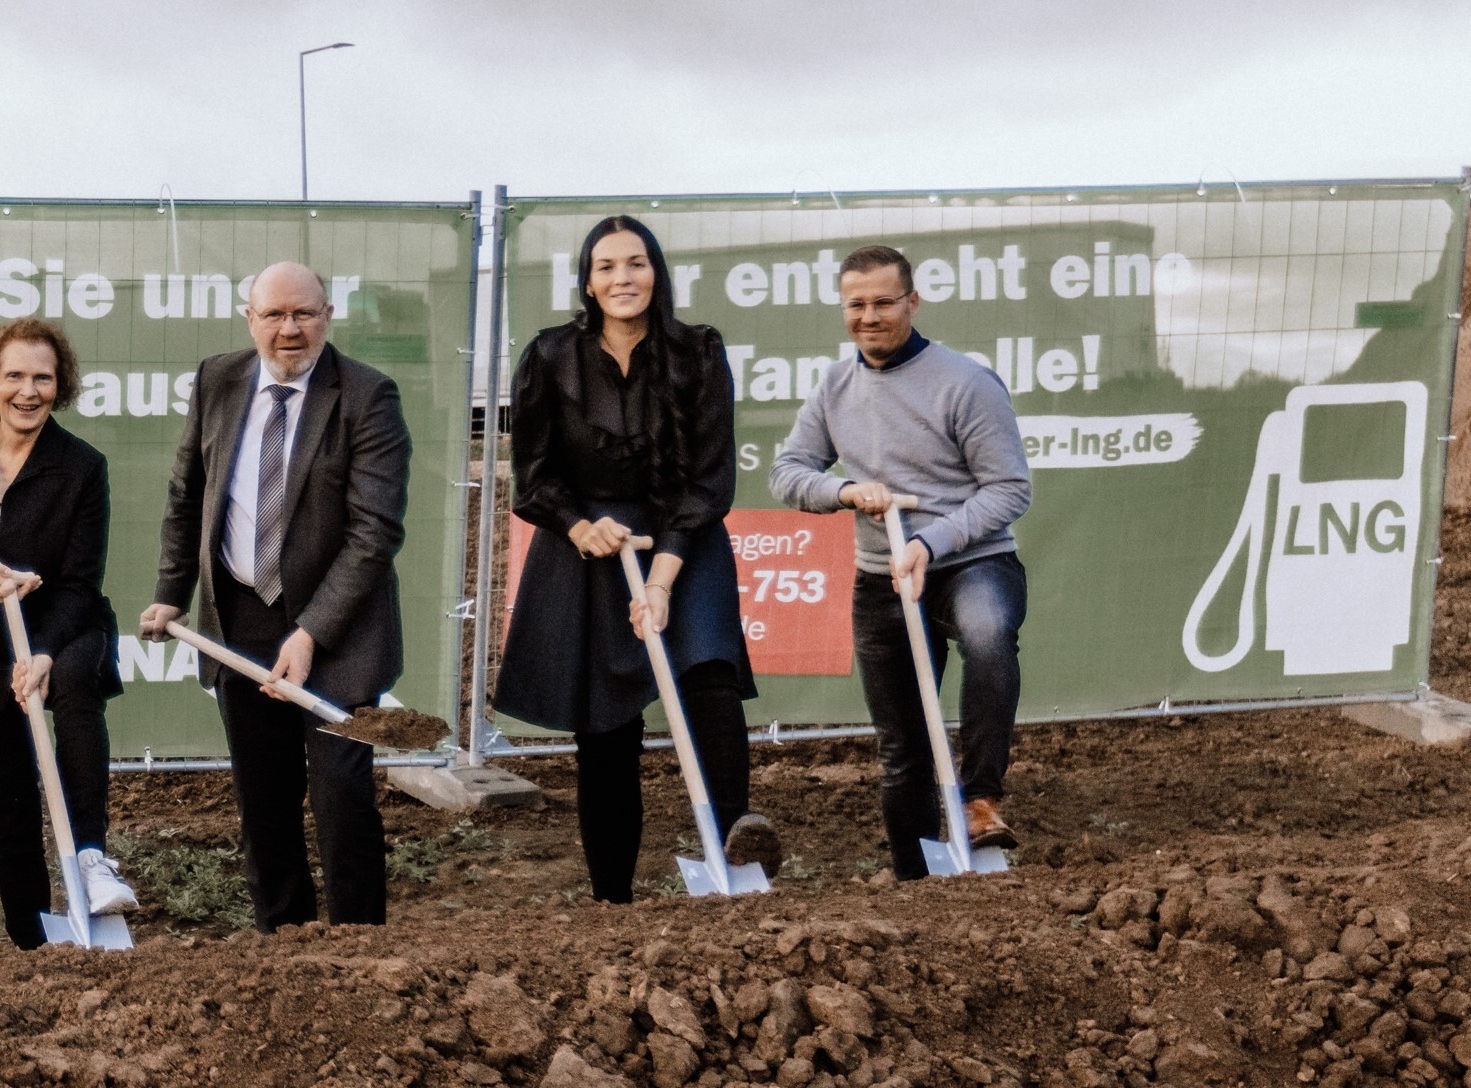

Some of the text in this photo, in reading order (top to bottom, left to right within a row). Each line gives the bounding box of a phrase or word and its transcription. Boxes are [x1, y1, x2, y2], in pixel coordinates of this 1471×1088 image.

[726, 244, 1027, 308] enteht
[1049, 241, 1194, 299] eine
[1024, 424, 1173, 461] er-lng.de
[730, 529, 812, 561] agen?
[1283, 500, 1406, 556] LNG
